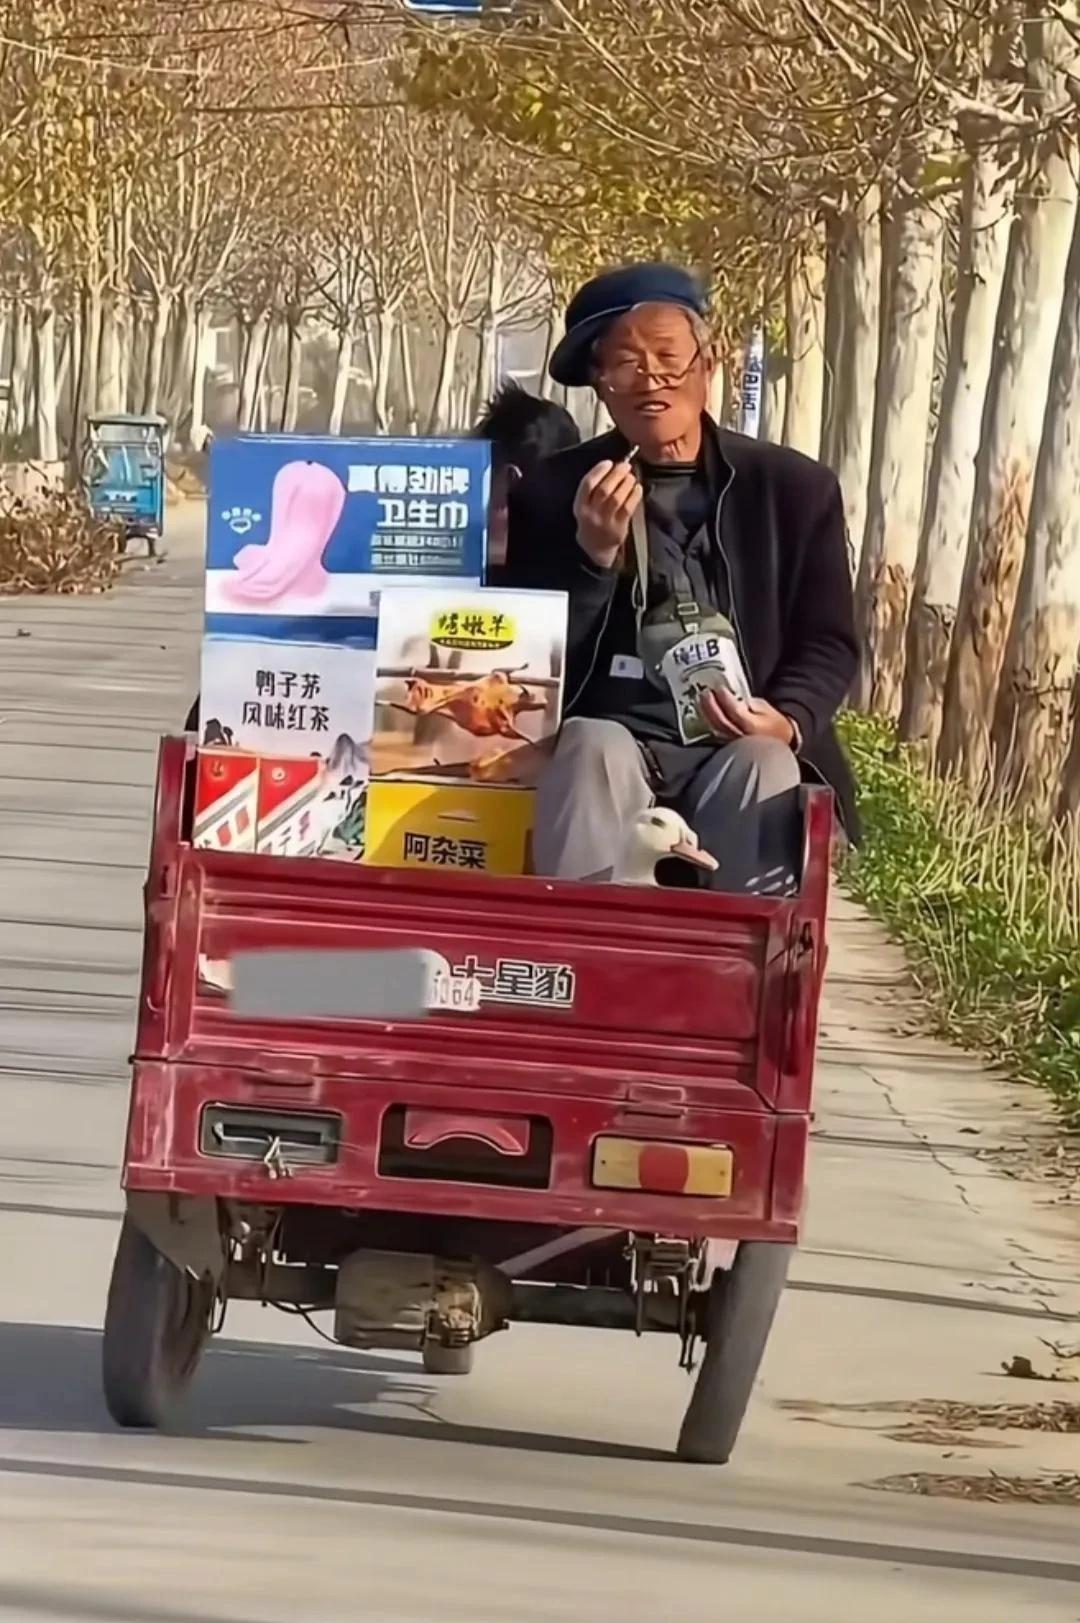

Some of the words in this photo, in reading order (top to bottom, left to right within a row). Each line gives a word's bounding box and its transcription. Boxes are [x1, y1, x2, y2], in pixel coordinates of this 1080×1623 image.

[348, 464, 470, 495] 劲牌
[376, 498, 469, 529] 卫生巾
[256, 669, 320, 699] 鸭子茅
[241, 701, 331, 732] 风味红茶
[404, 832, 487, 868] 阿杂菜
